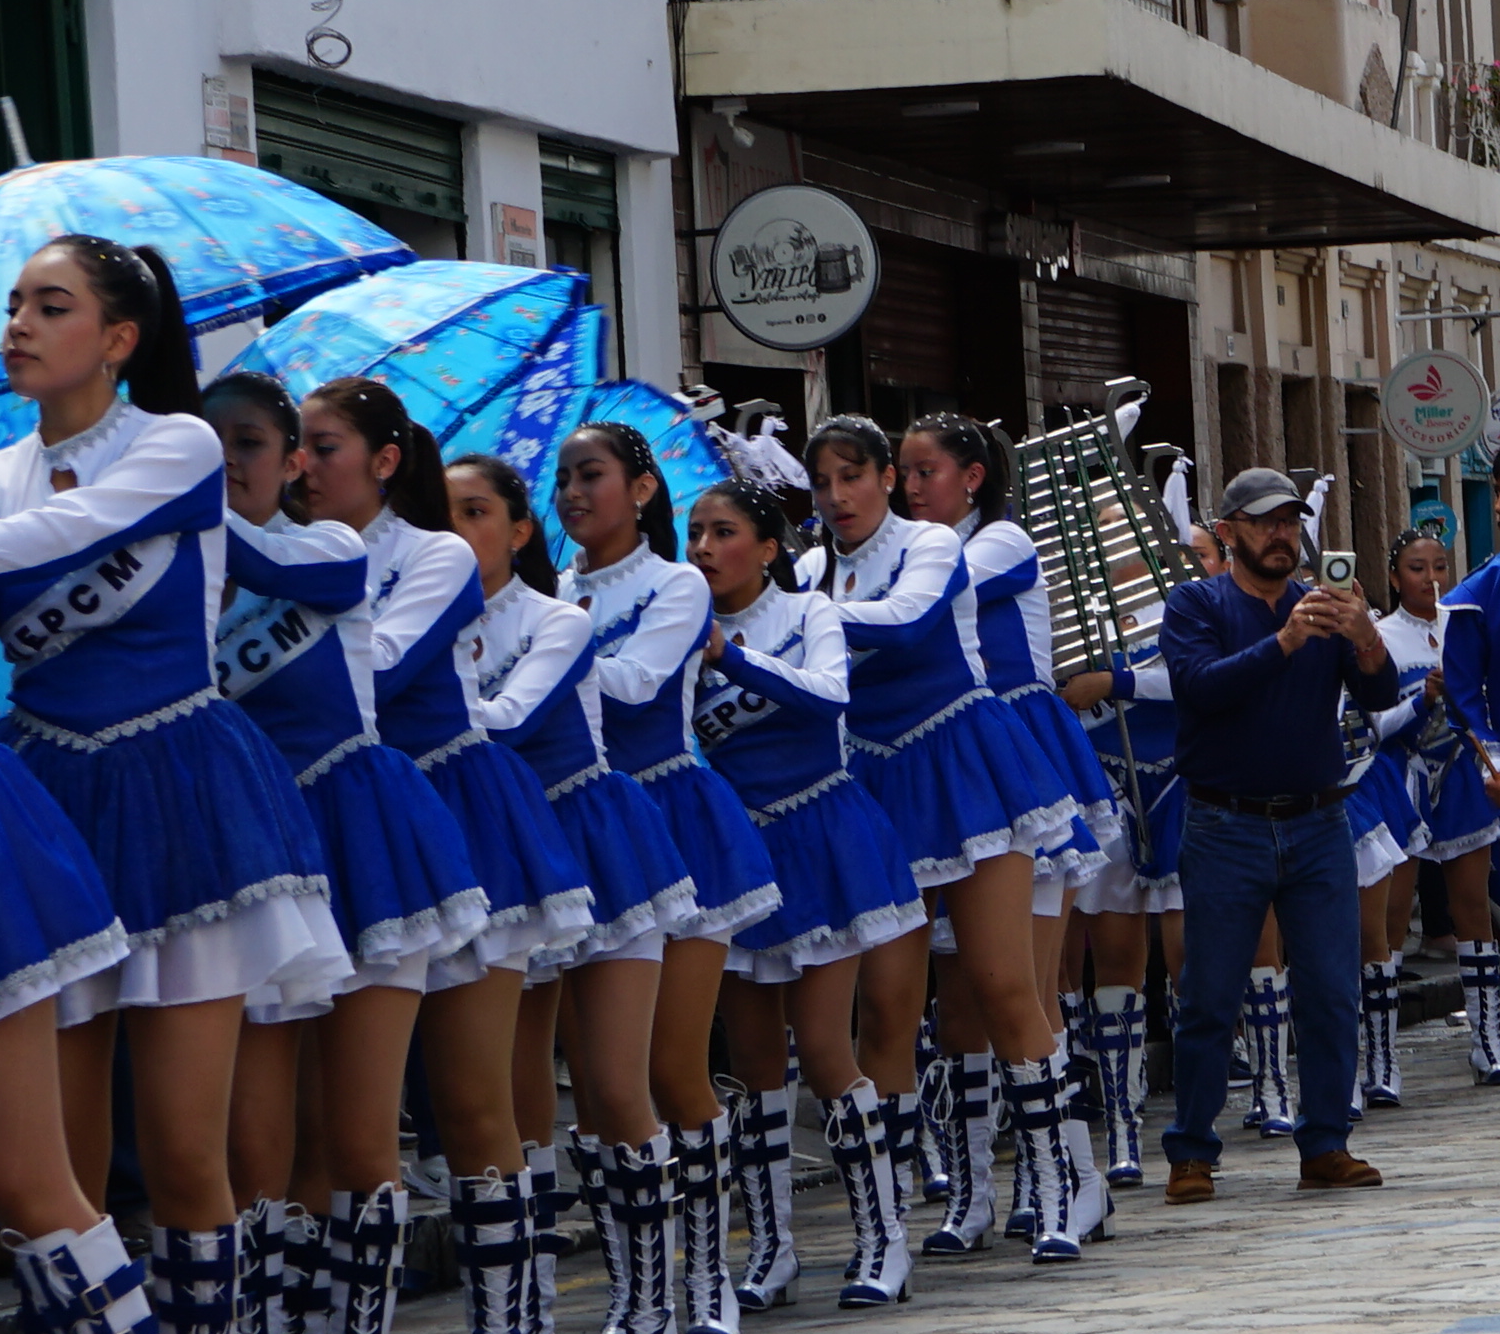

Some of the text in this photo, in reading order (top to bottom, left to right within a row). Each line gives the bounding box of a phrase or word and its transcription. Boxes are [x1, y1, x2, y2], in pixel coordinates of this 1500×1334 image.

[1398, 413, 1472, 444] ACCESORIOS
[1414, 405, 1454, 425] Miller
[694, 689, 767, 748] EPC
